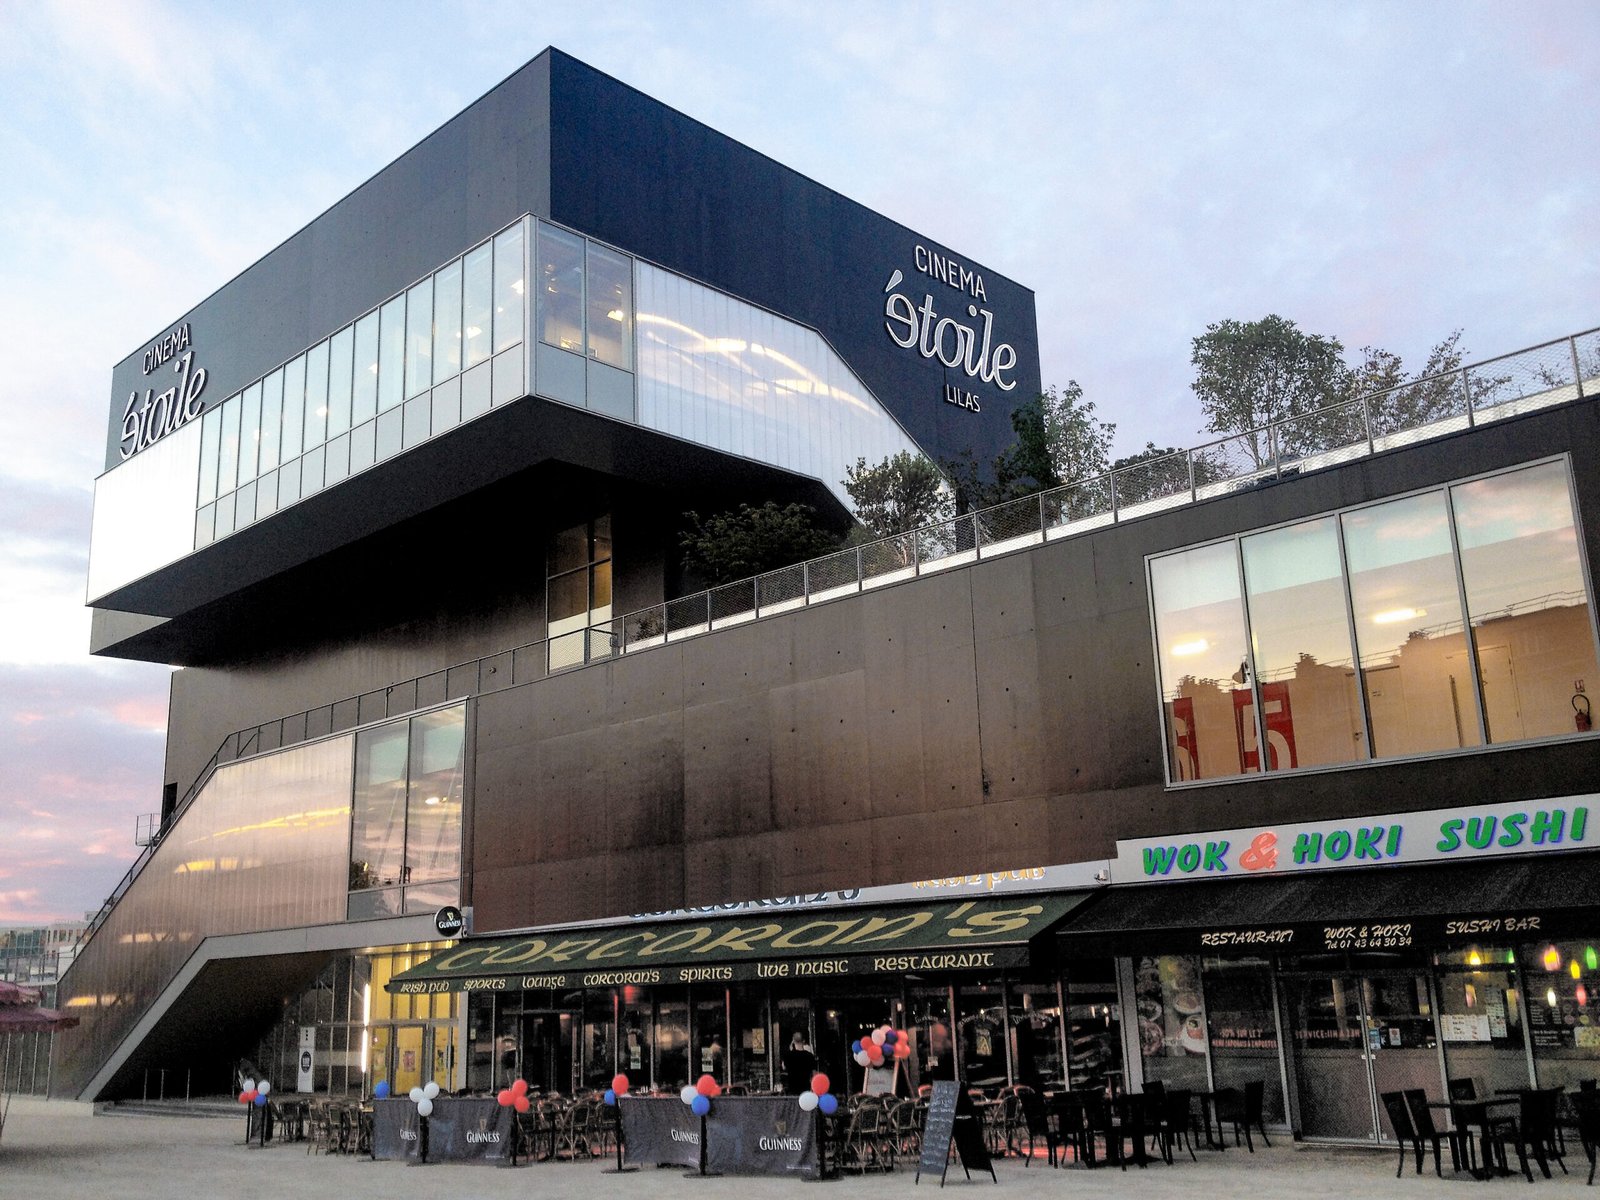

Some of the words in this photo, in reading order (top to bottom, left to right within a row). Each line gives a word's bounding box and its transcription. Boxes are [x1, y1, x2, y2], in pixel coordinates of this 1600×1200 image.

[915, 245, 987, 302] CINEMA
[884, 269, 1017, 391] étoile
[142, 323, 191, 375] CINEMA
[119, 350, 206, 460] étoile
[946, 384, 981, 412] LILAS
[1142, 840, 1230, 875] WOK
[1238, 830, 1278, 871] &
[1292, 825, 1403, 864] HOKI
[1435, 806, 1589, 853] SUSHI
[1323, 927, 1357, 940] WOK
[1358, 926, 1368, 938] &
[1371, 923, 1412, 938] HOKI
[1446, 919, 1501, 935] SUSHI
[1504, 916, 1541, 932] BAR
[1201, 930, 1294, 946] RESTAURANT
[1339, 940, 1351, 949] 01
[1354, 938, 1367, 948] 43
[1384, 937, 1397, 947] 30
[1398, 936, 1412, 946] 34
[466, 1131, 500, 1144] GUINNESS
[670, 1129, 700, 1145] GUINNESS
[759, 1136, 802, 1151] GUINNESS
